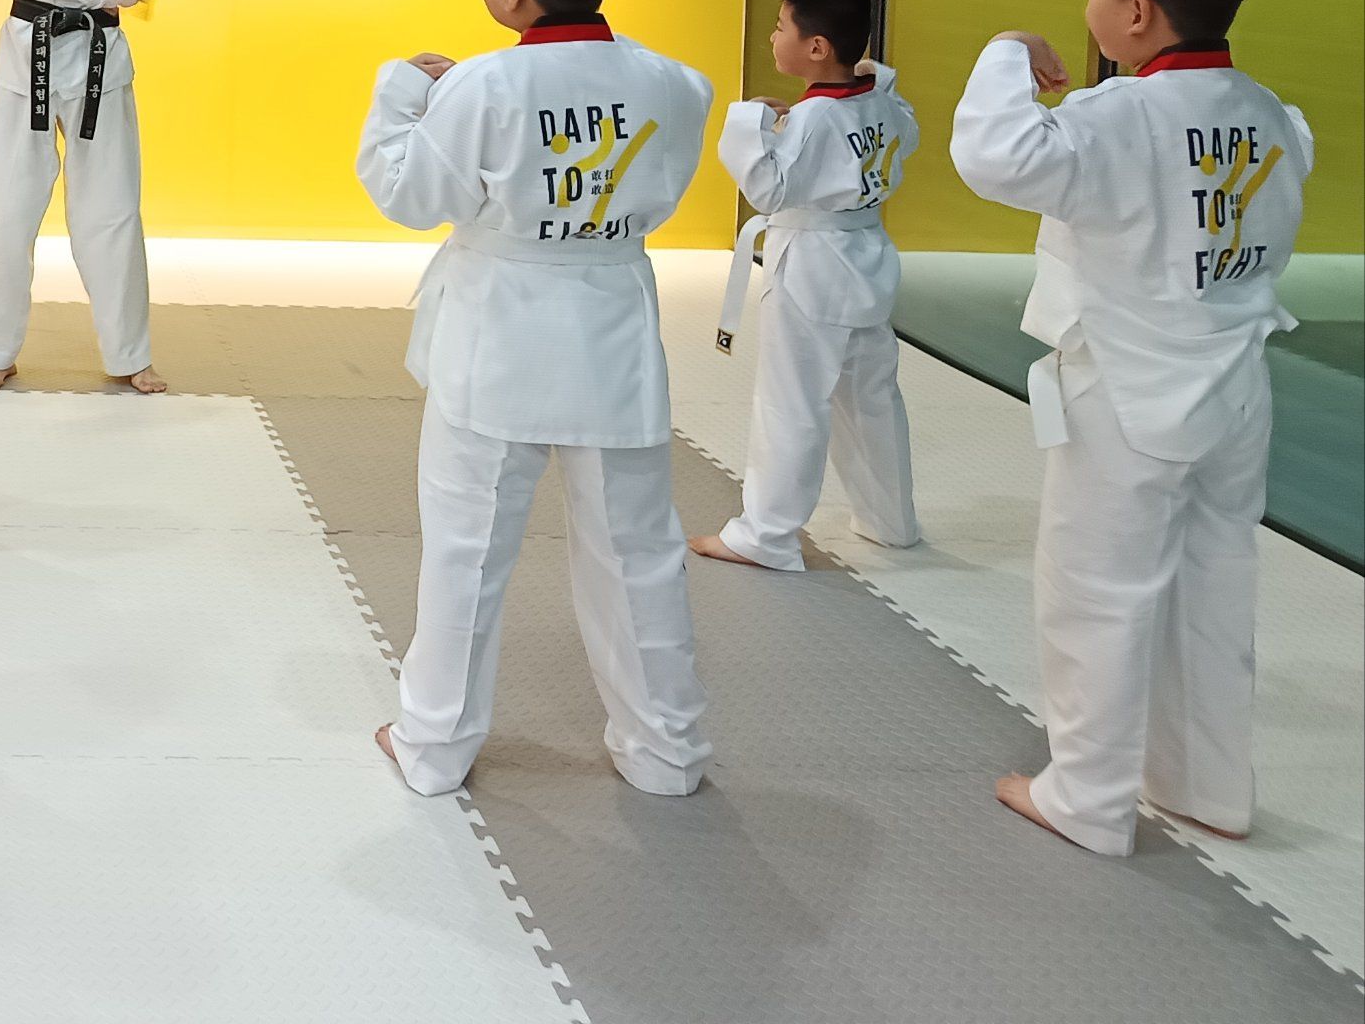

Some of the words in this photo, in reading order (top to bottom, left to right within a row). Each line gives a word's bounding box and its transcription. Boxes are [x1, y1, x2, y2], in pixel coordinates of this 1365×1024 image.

[539, 103, 629, 147] DARE
[847, 122, 884, 159] DARE
[1186, 126, 1259, 167] DARE
[542, 166, 583, 205] TO
[1192, 189, 1225, 228] TO
